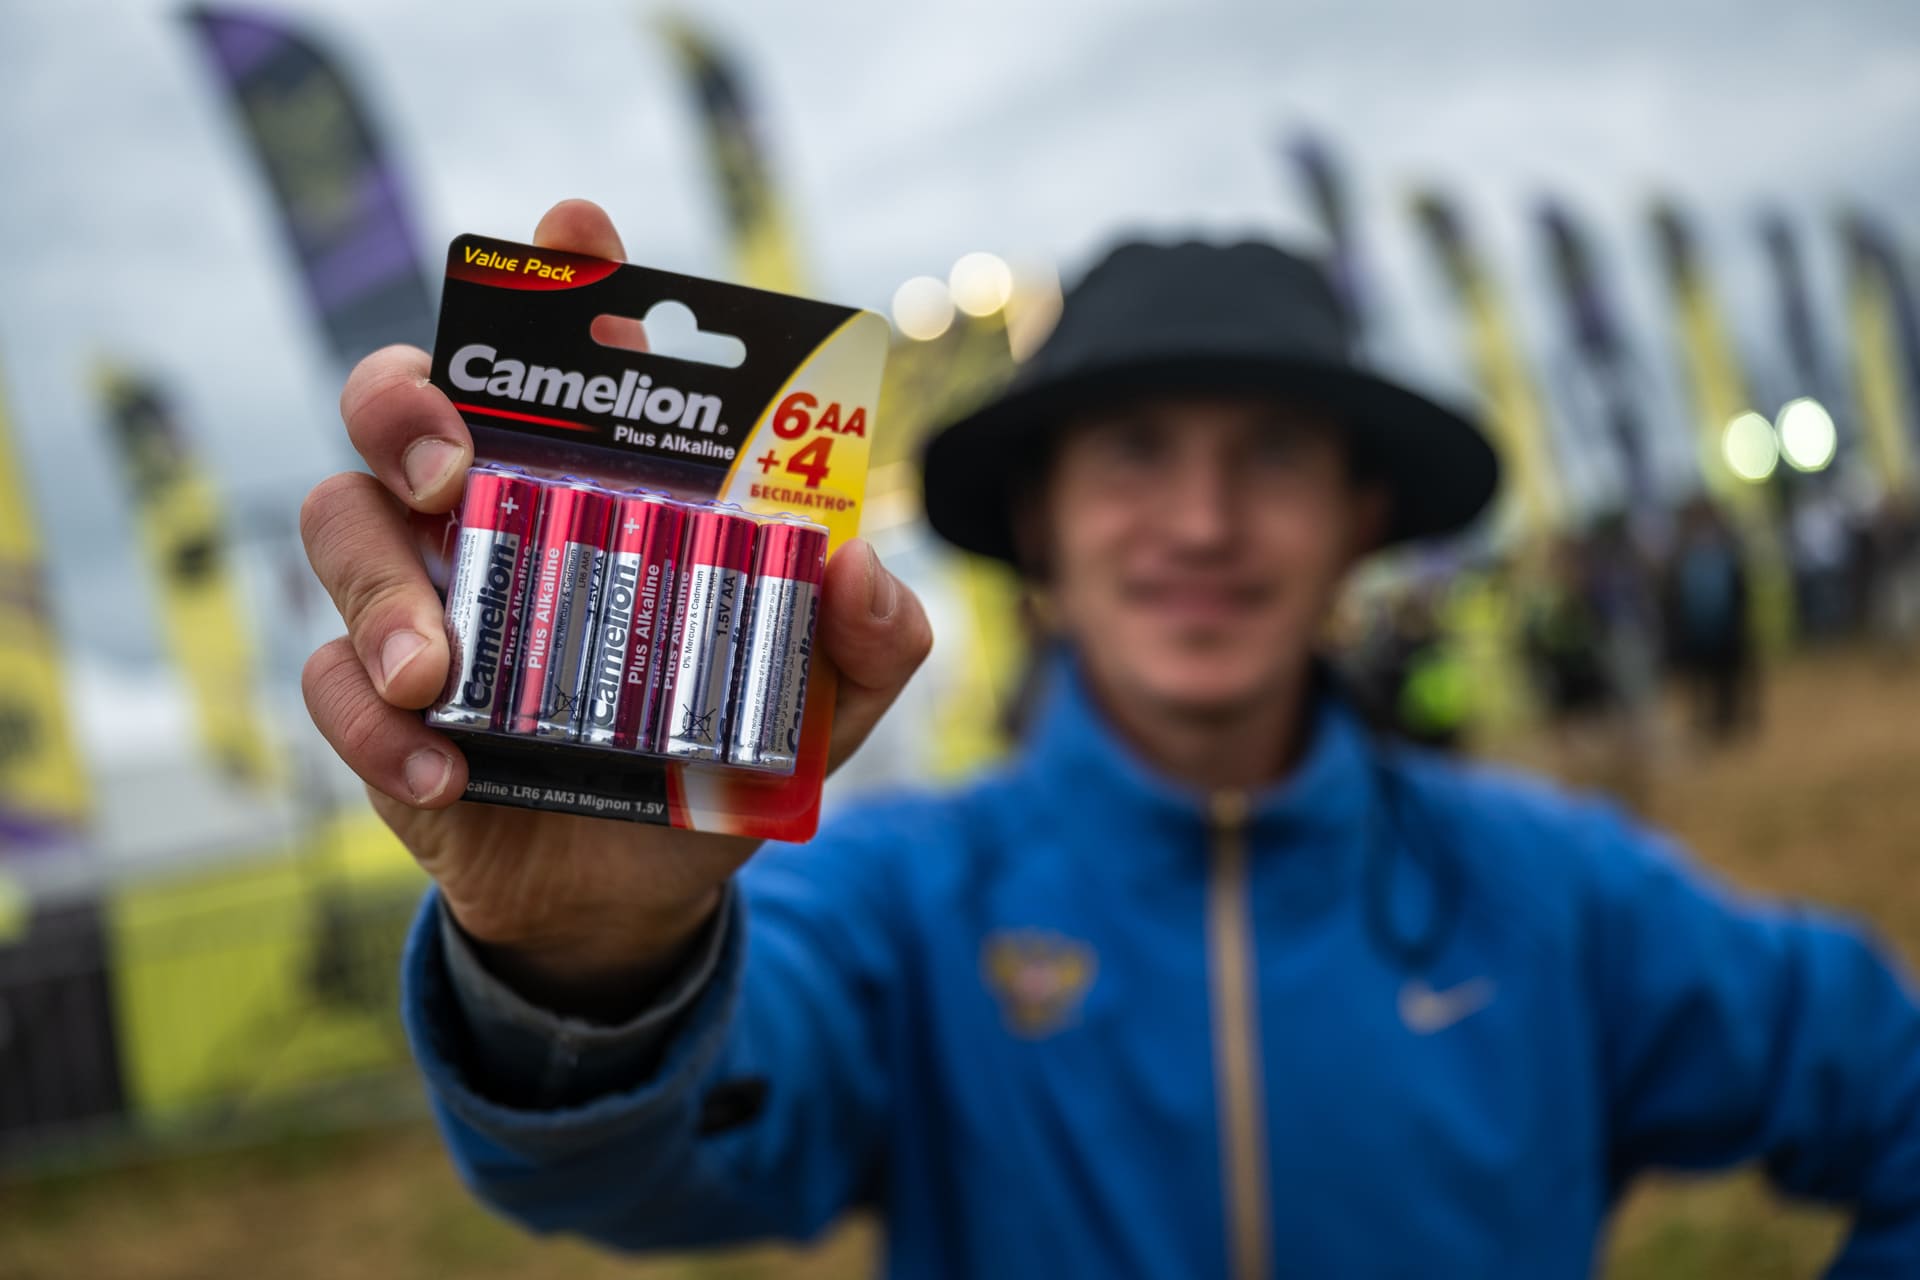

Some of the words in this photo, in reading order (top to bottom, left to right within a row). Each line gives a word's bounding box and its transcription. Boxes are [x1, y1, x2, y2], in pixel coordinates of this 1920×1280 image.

[464, 245, 518, 272] Value
[523, 257, 576, 283] Pack
[614, 424, 655, 450] Plus
[660, 432, 735, 460] Alkaline
[563, 548, 577, 588] Cadmium
[580, 550, 590, 570] AM3
[535, 547, 560, 622] Alkaline
[577, 571, 587, 588] LR6
[691, 569, 703, 609] Cadmium
[723, 576, 735, 598] AA
[504, 625, 518, 666] Plus
[512, 544, 532, 620] Alkaline
[557, 599, 570, 633] Mercury
[635, 563, 660, 640] Alkaline
[670, 570, 690, 644] Alkaline
[717, 602, 731, 637] 1.5V
[529, 628, 547, 669] Plus
[684, 620, 697, 653] Mercury
[628, 643, 648, 685] Plus
[663, 649, 678, 690] Plus
[682, 655, 691, 668] 0%
[466, 781, 508, 796] caline
[512, 785, 540, 799] LR6
[543, 789, 575, 804] AM3
[579, 793, 630, 812] Mignon
[635, 801, 664, 815] 1.5V
